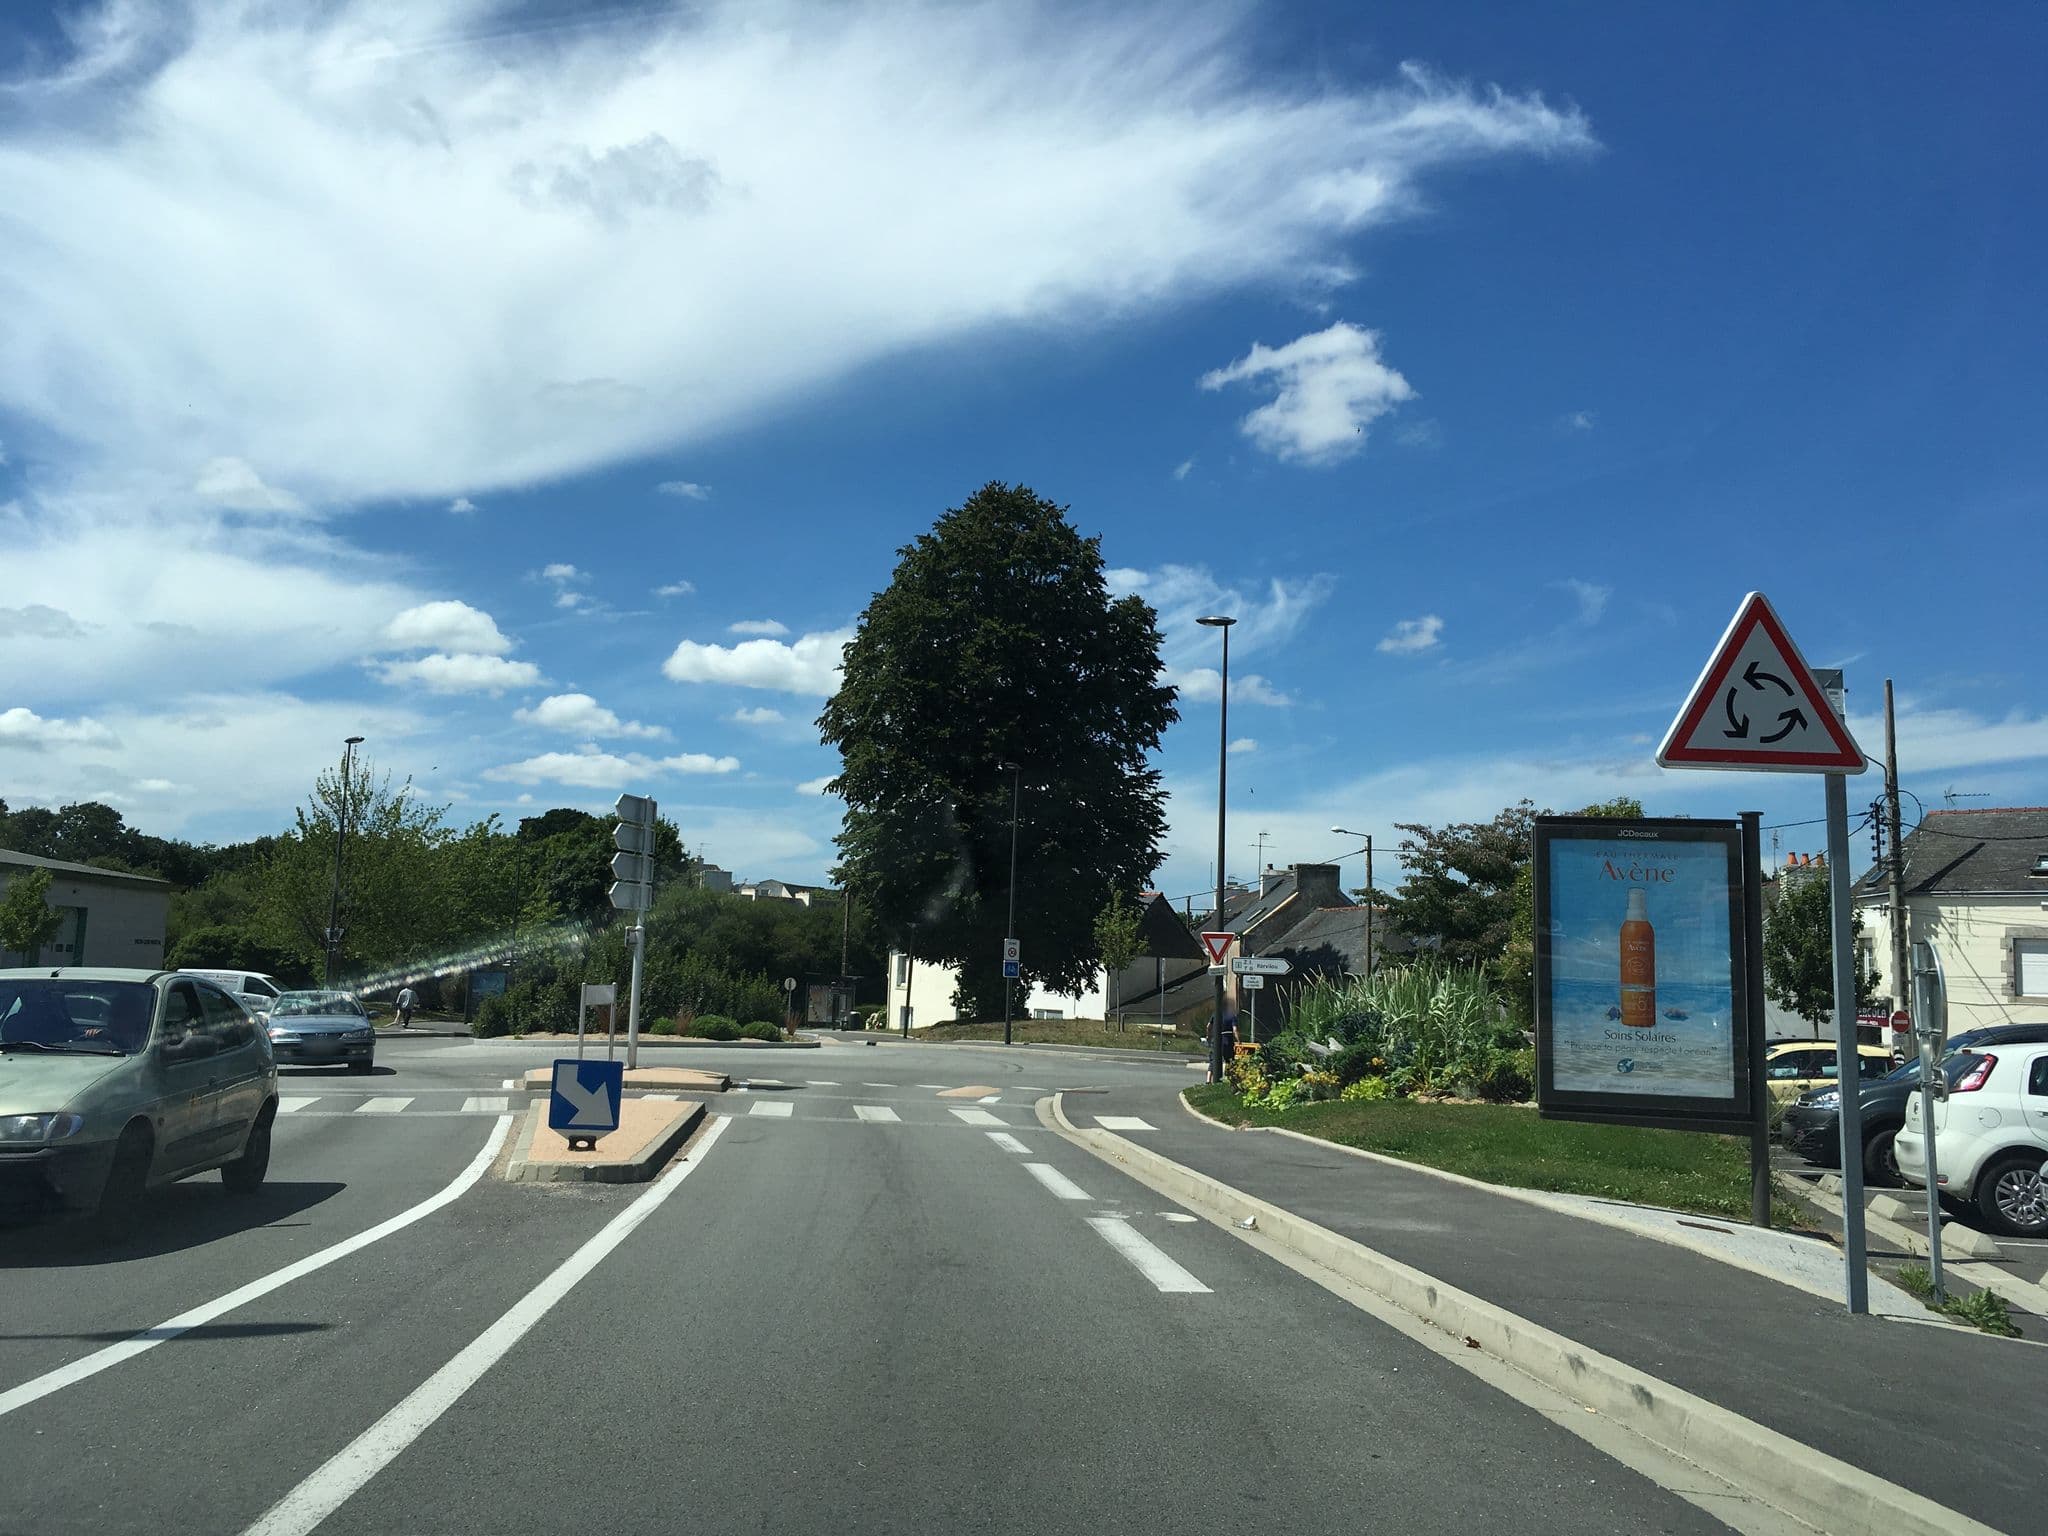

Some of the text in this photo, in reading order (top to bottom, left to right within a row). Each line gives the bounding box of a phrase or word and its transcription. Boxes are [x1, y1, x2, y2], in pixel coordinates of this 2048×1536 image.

[1617, 829, 1659, 838] JCDecaux
[1599, 860, 1676, 883] Avène
[1604, 1029, 1677, 1043] Soins Solaires
